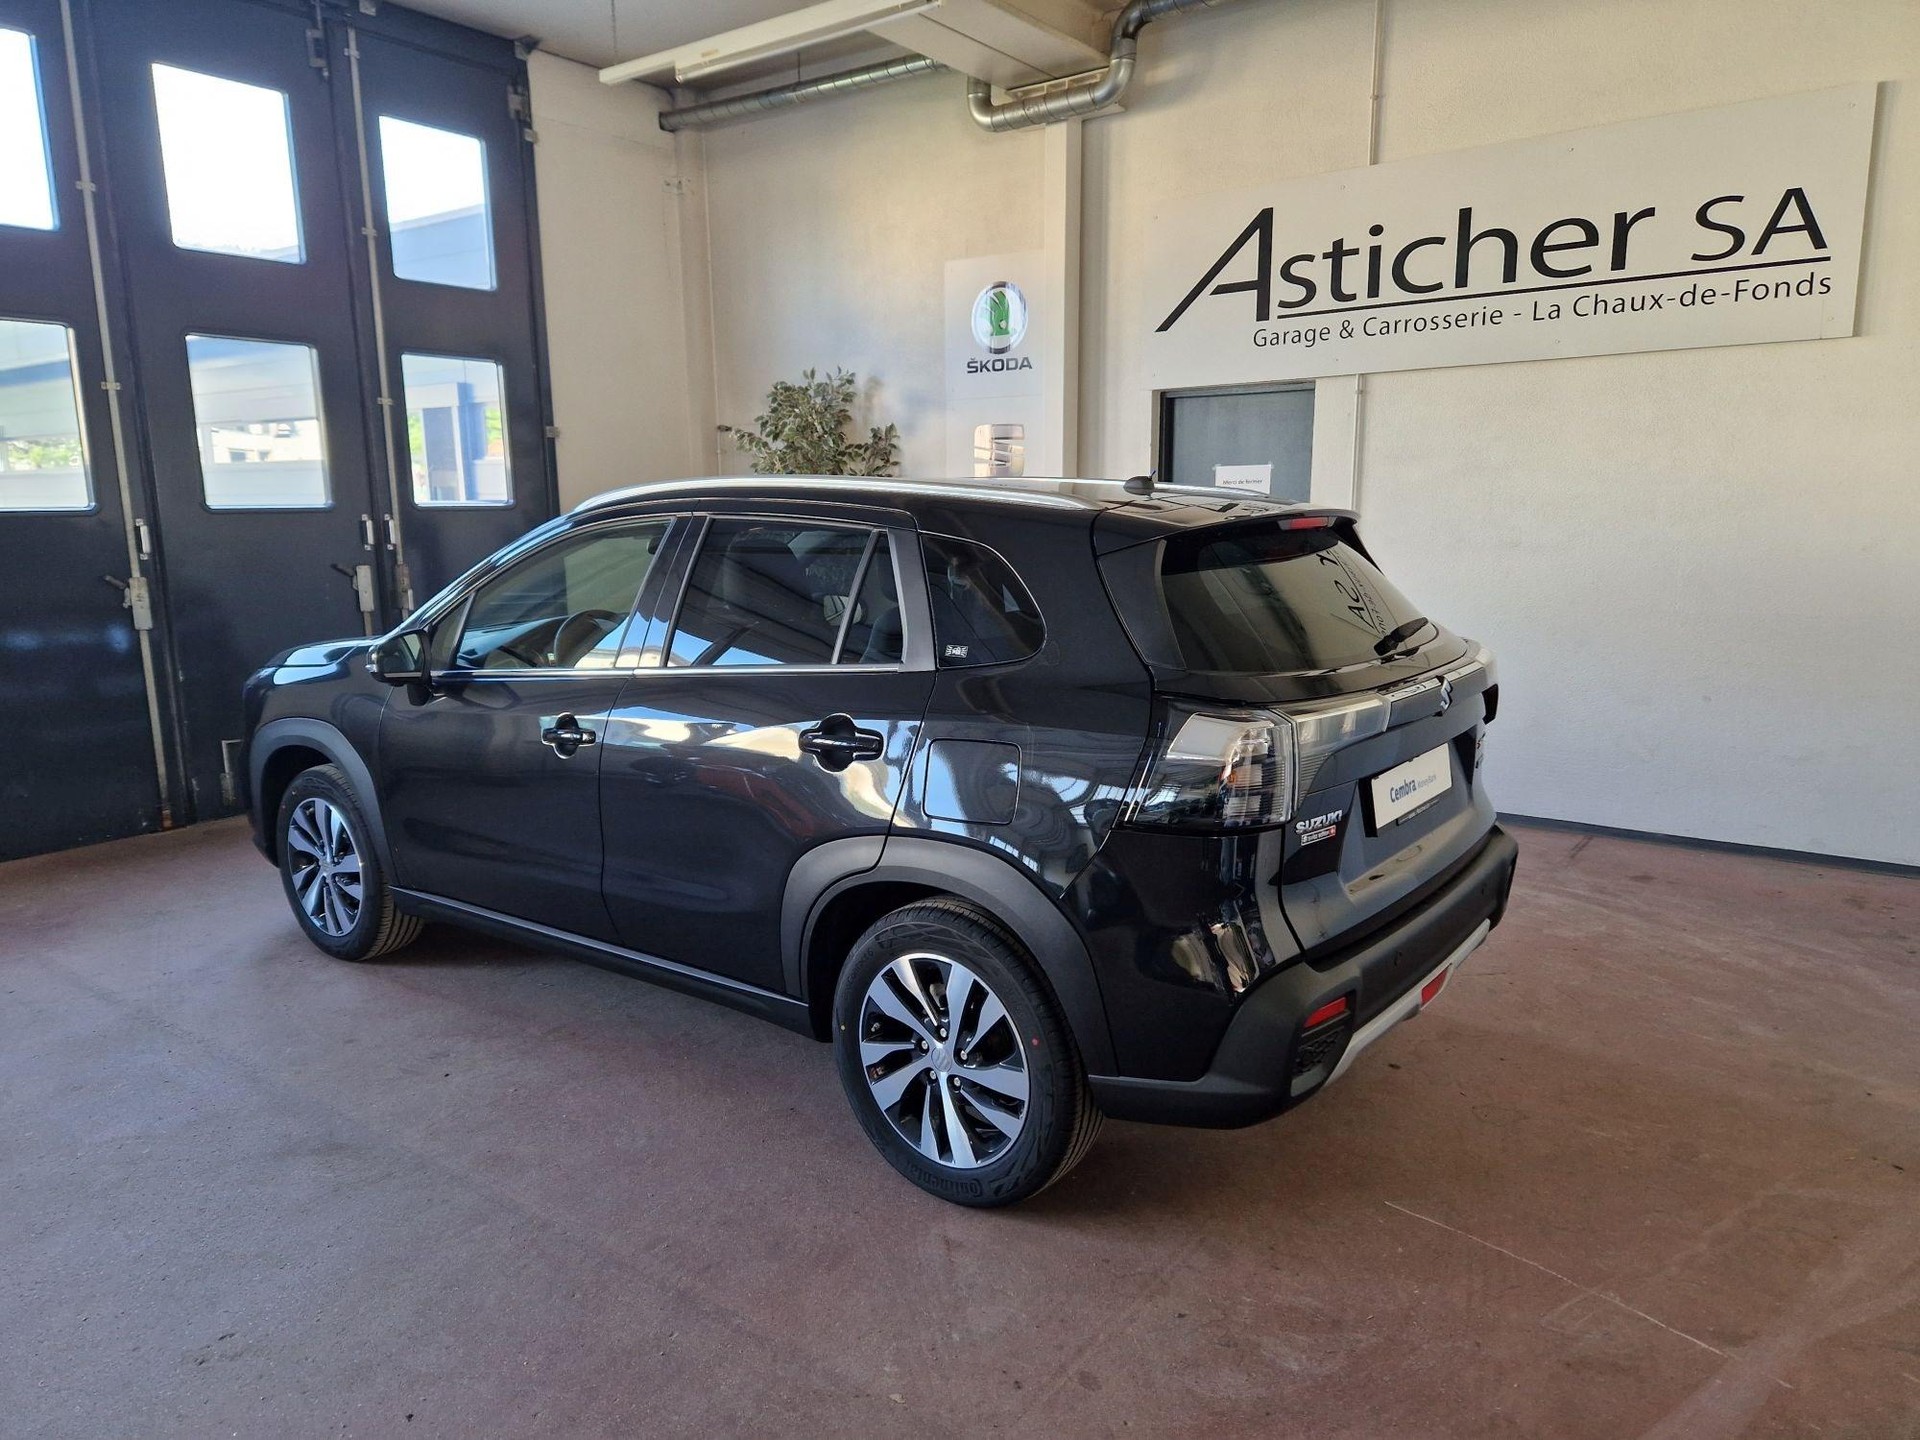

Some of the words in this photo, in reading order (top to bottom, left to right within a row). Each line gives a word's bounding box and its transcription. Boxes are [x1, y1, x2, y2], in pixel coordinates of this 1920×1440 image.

[1155, 207, 1656, 333] Asticher
[1691, 187, 1828, 262] SA
[1253, 326, 1331, 348] Garage
[1339, 319, 1354, 339] &
[1363, 306, 1503, 337] Carrosserie
[1532, 300, 1561, 322] La
[1572, 272, 1832, 318] Chaux-de-Fonds
[966, 357, 1033, 374] ŠKODA
[1389, 778, 1417, 803] Cembra
[1295, 809, 1343, 834] SUZUKI
